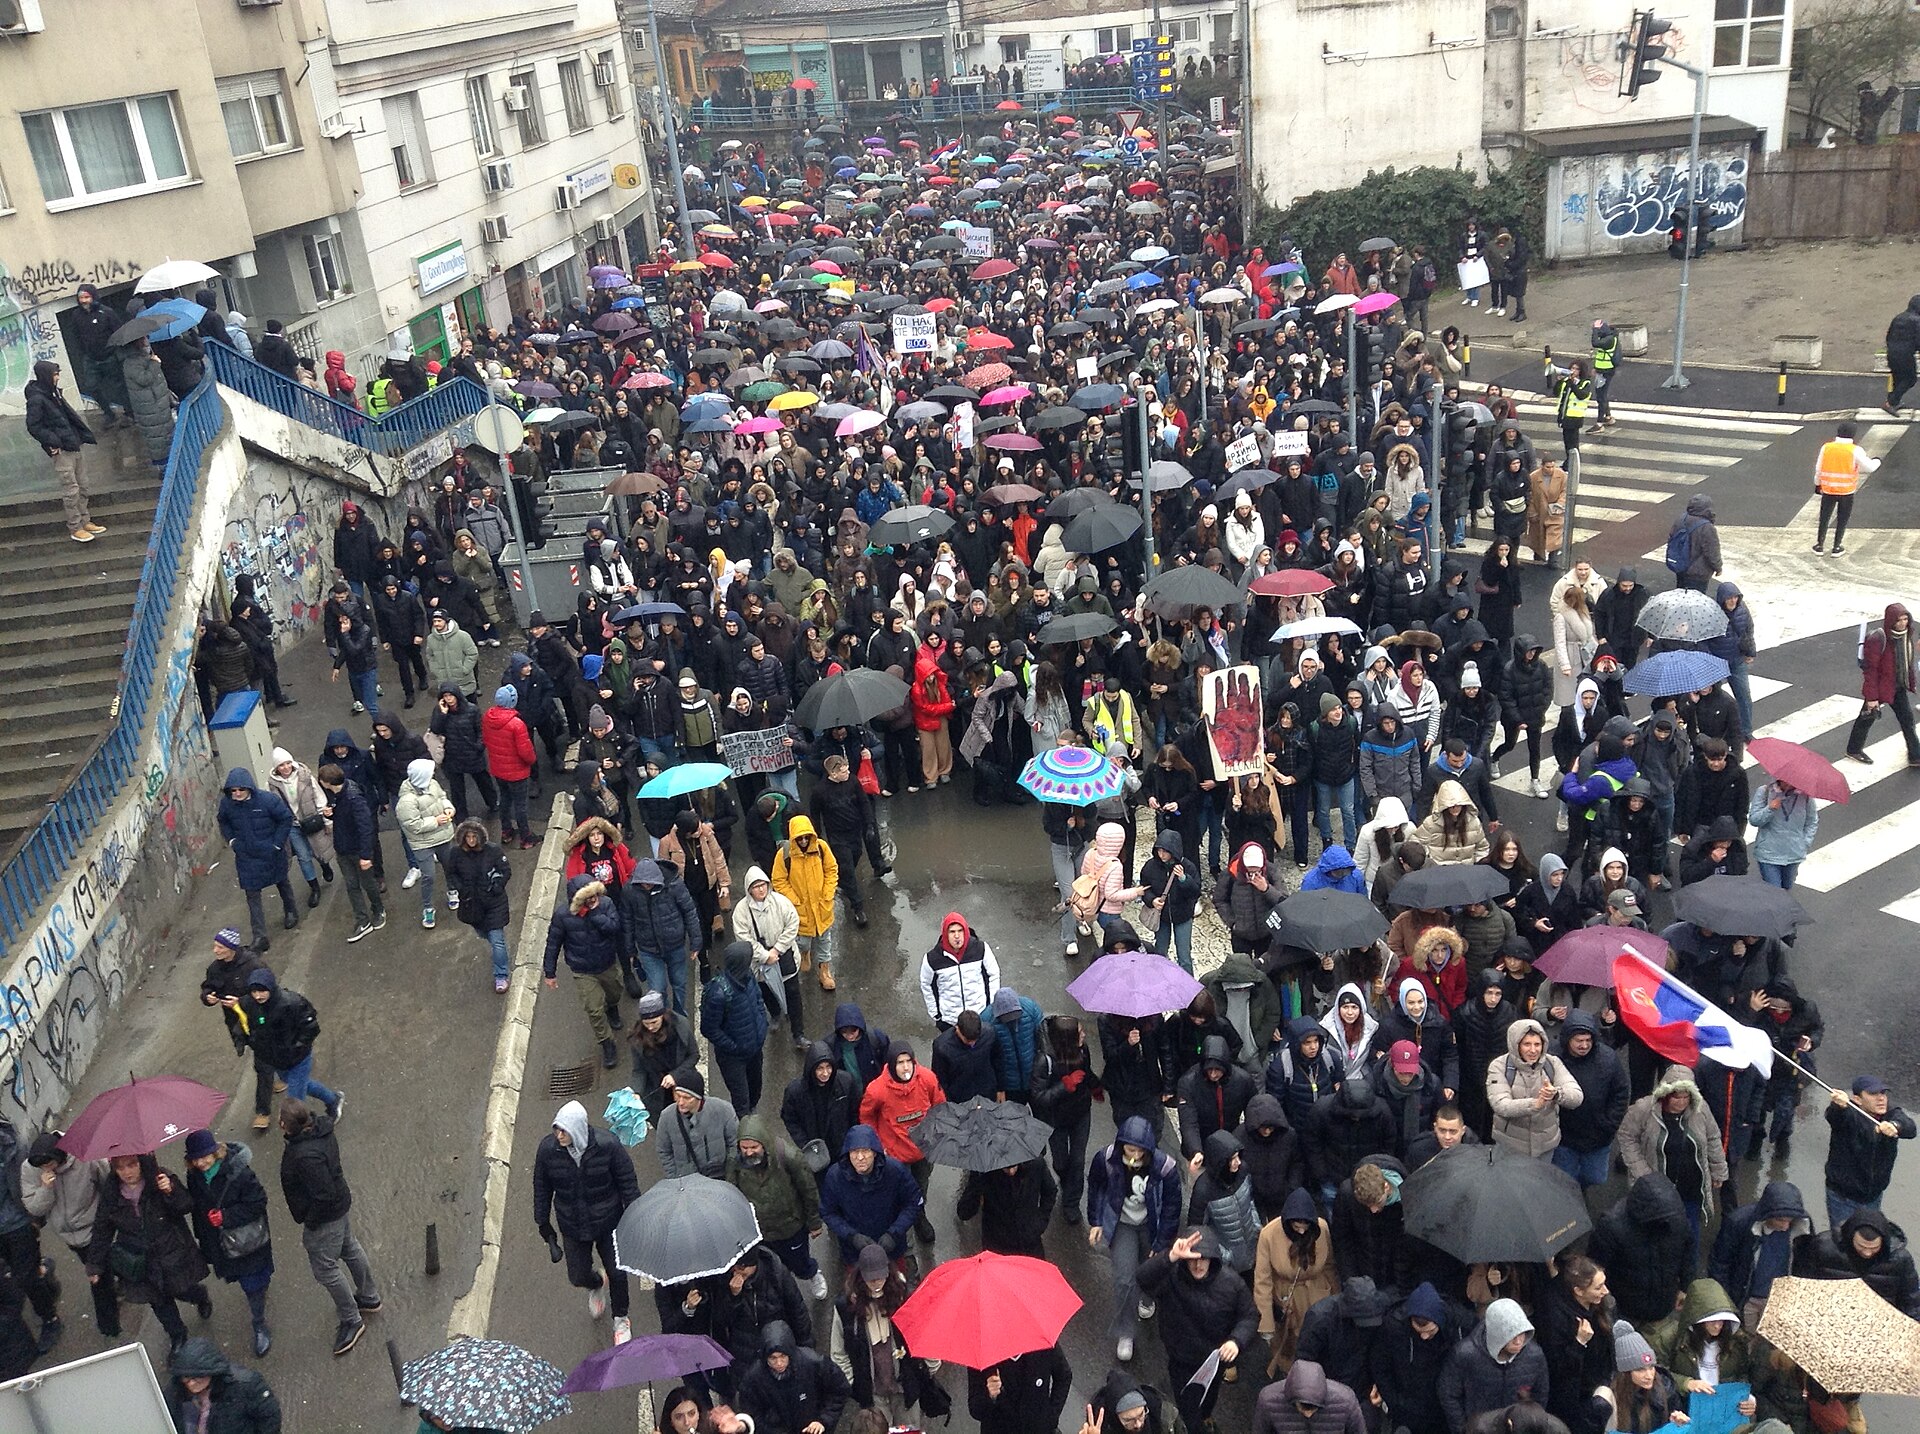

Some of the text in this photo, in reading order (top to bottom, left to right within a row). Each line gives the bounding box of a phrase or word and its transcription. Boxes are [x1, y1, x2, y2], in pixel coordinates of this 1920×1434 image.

[428, 254, 465, 279] Good Dumplings
[912, 315, 932, 327] НАС
[894, 327, 908, 337] СТЕ
[1233, 441, 1245, 450] МИ
[1235, 454, 1252, 465] ЧАС
[750, 750, 792, 772] СРАМОТА
[734, 767, 746, 776] СЕ
